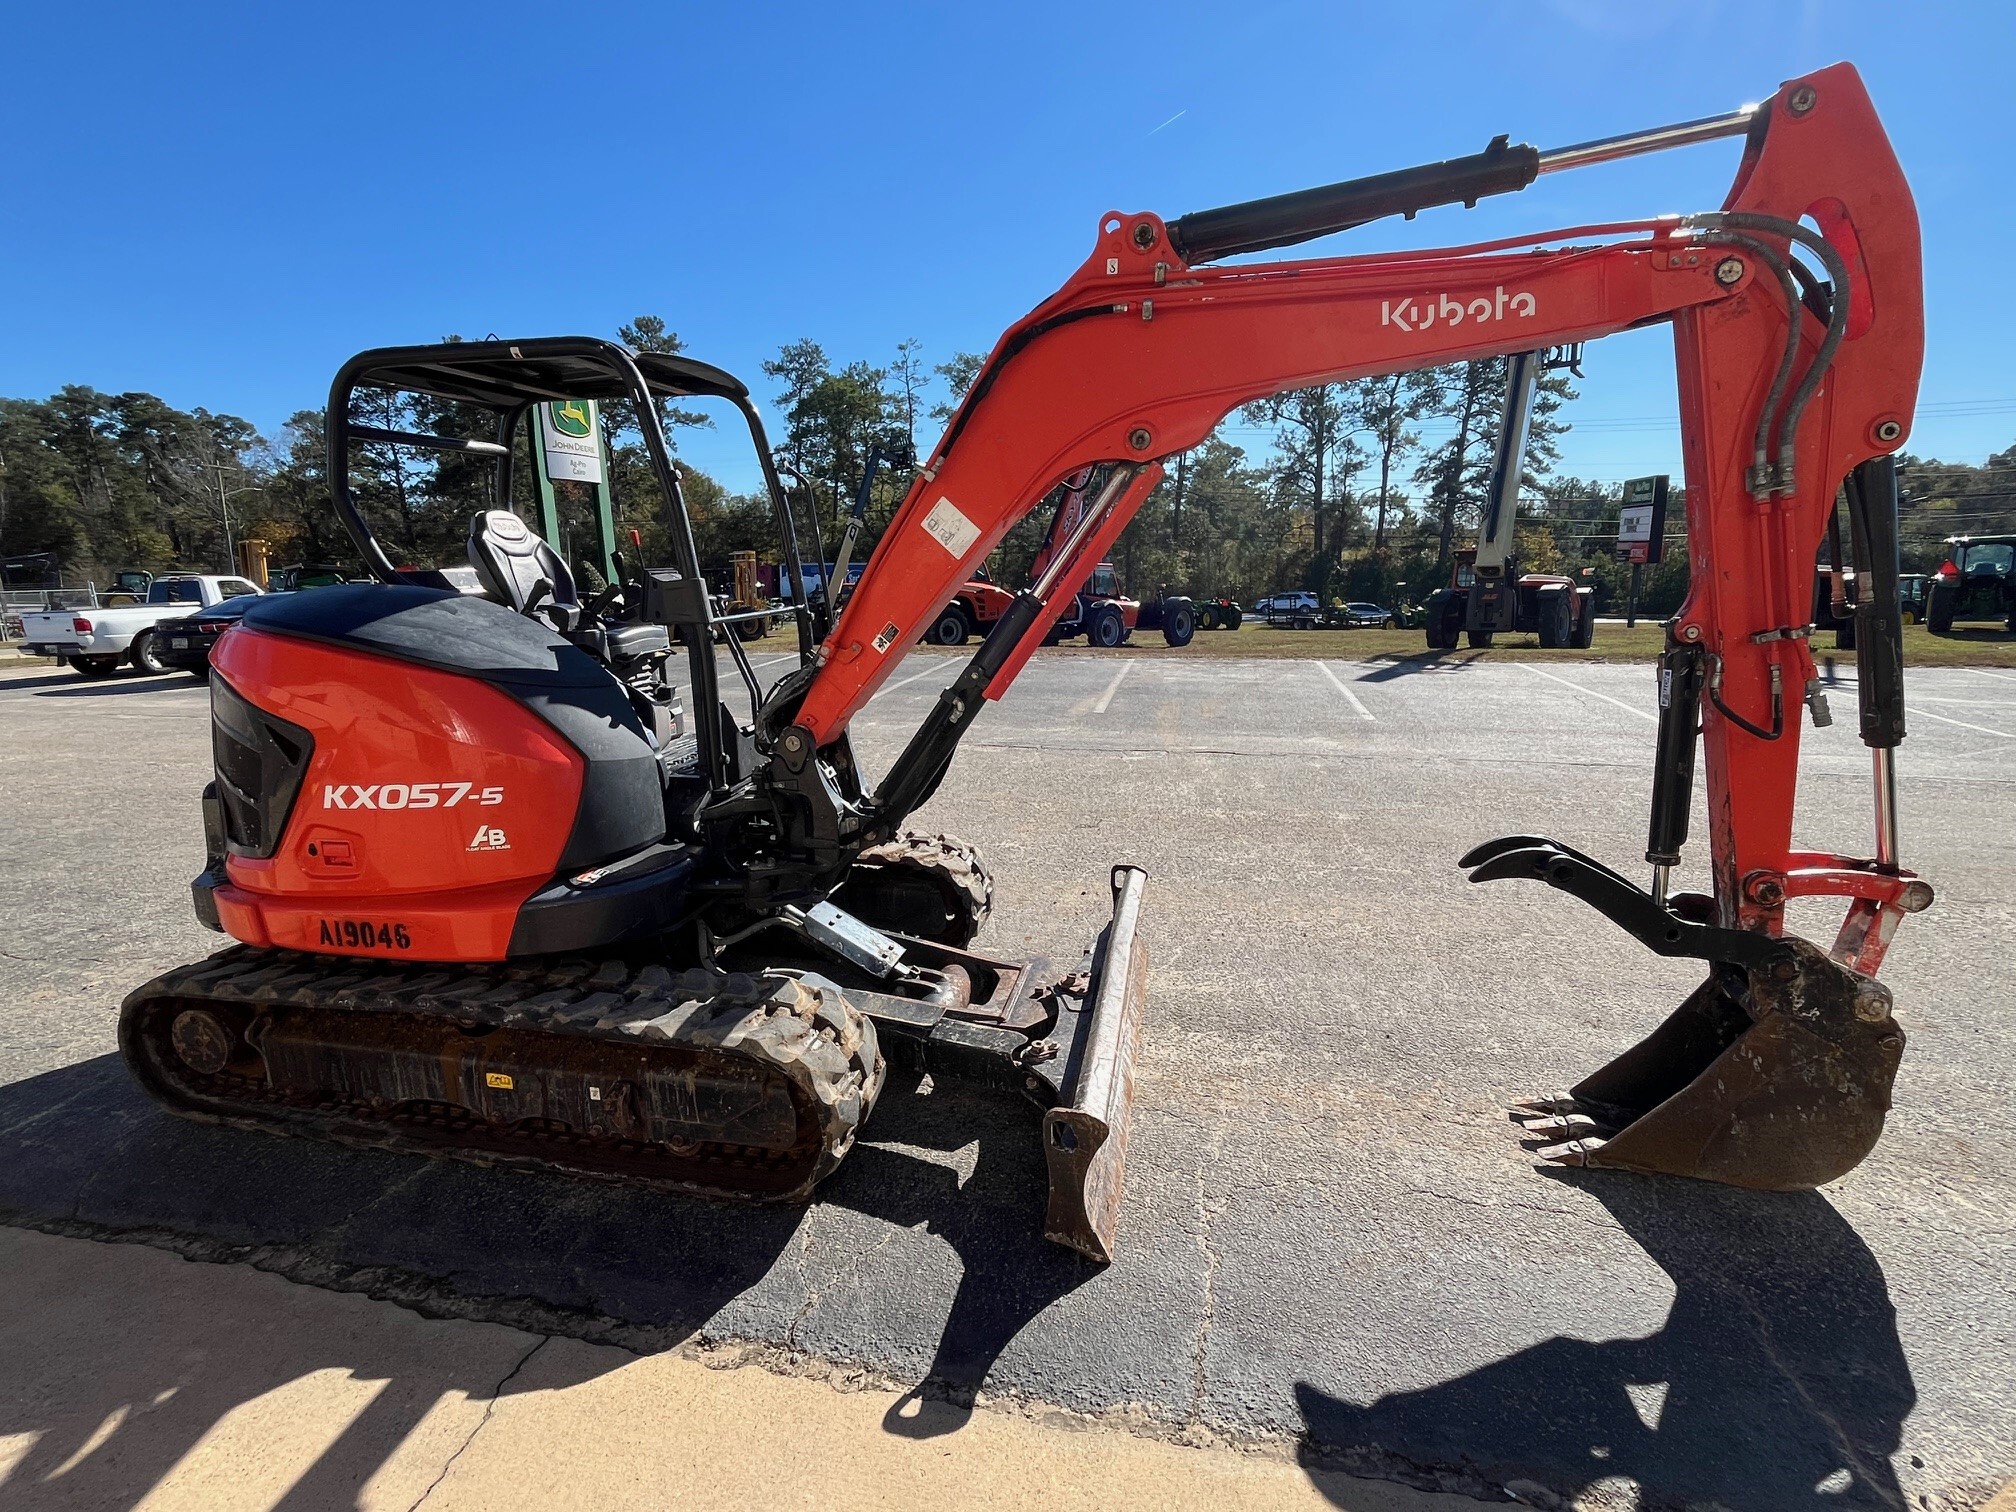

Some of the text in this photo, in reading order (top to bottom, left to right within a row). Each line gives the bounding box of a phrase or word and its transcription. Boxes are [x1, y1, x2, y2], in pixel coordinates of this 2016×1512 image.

[1381, 285, 1536, 332] Kubota
[552, 441, 595, 454] JOHN DEERE
[322, 782, 504, 810] KX057-5
